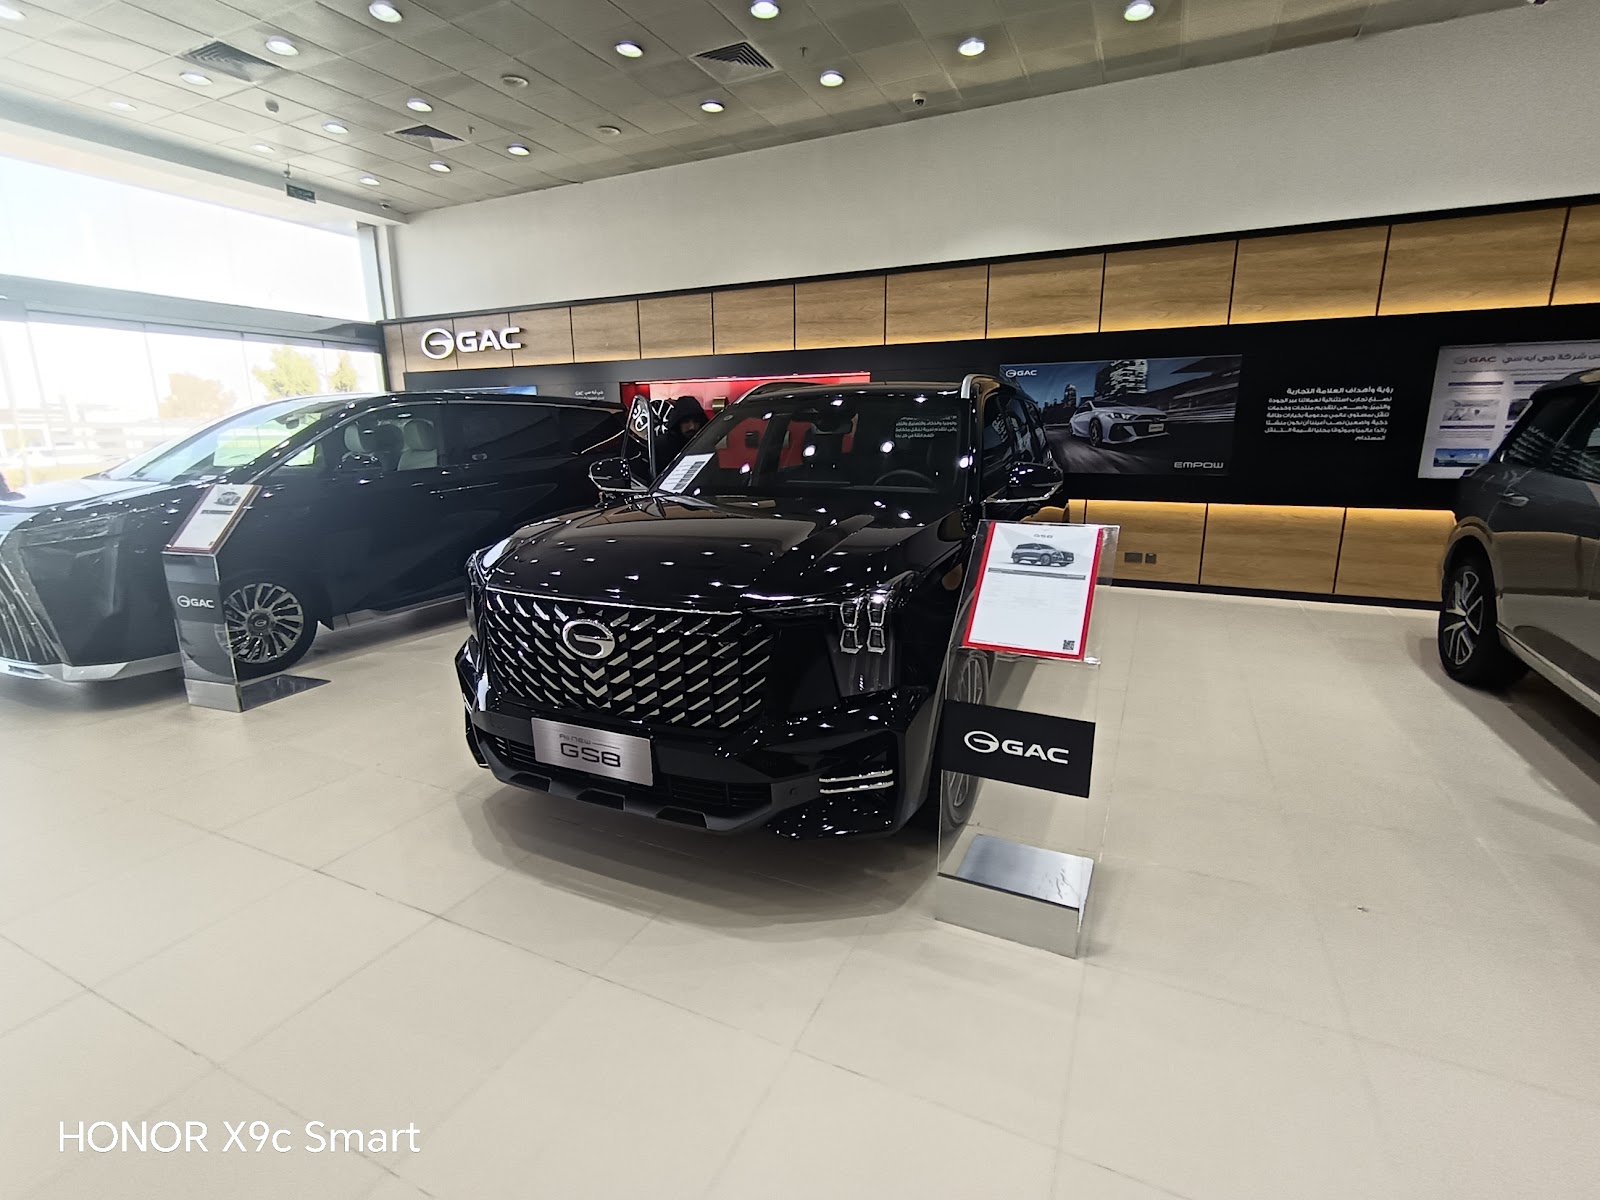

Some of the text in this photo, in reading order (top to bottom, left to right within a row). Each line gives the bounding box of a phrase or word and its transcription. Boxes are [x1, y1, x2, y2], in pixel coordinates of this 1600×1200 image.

[456, 327, 521, 352] GAC
[1558, 352, 1587, 361] شركة
[1173, 461, 1224, 470] EMPOW
[190, 598, 215, 608] GAC
[560, 742, 621, 768] GS8
[1001, 739, 1069, 764] GAC
